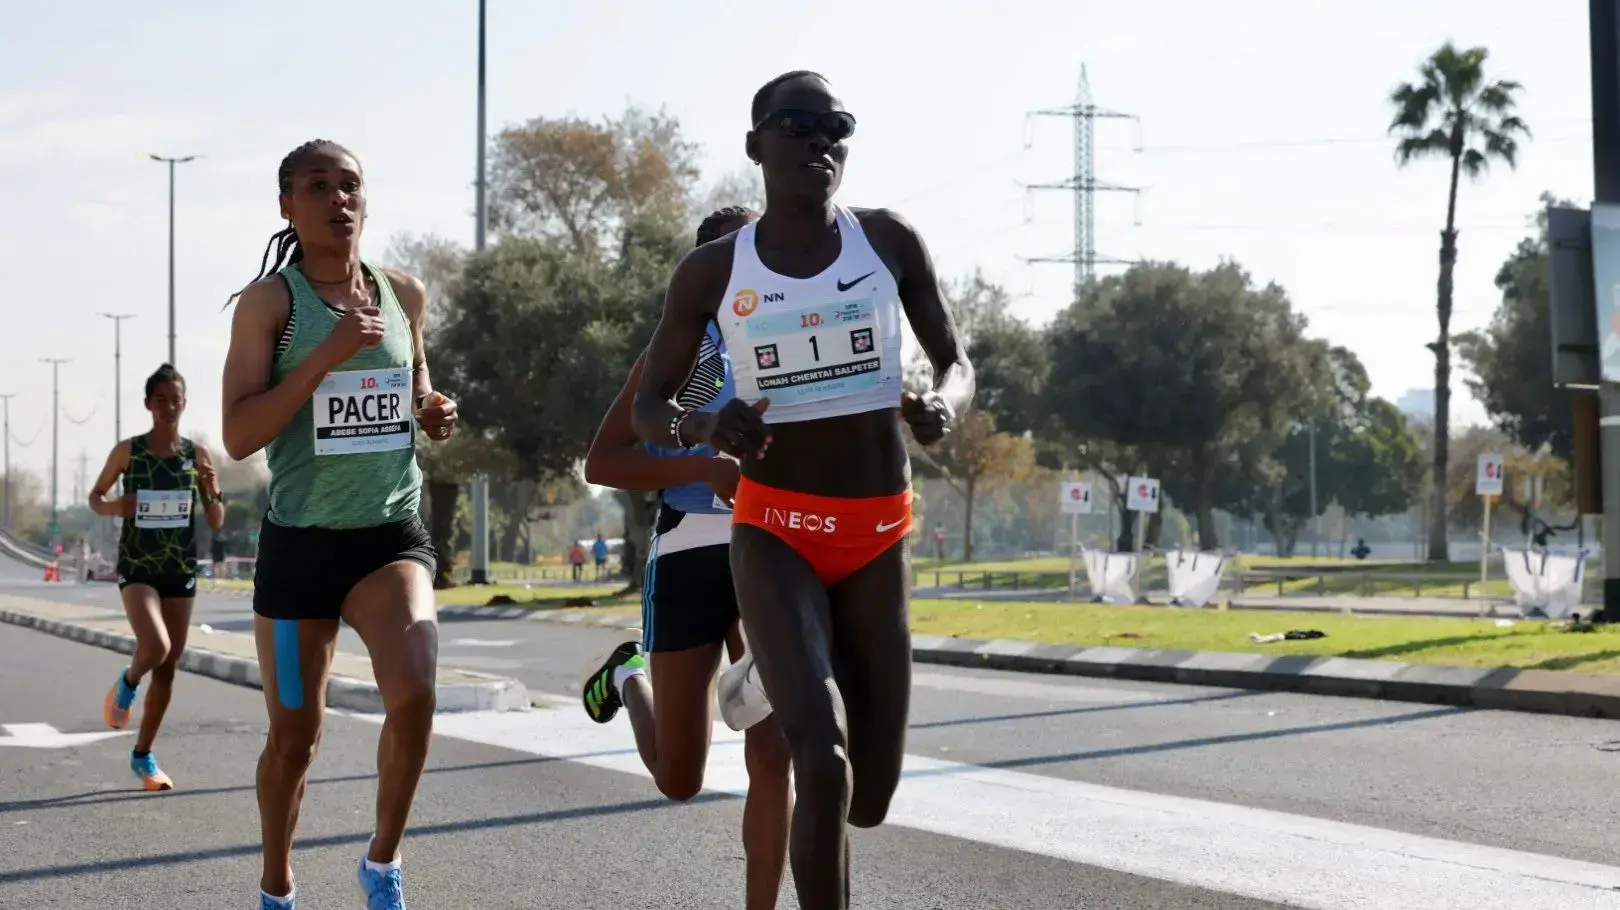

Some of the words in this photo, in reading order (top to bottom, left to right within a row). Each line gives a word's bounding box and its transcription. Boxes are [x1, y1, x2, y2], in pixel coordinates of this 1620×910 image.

[763, 292, 785, 303] NN
[809, 335, 820, 362] 1
[758, 375, 789, 388] LONAH
[791, 369, 833, 384] CHEMTAI
[834, 360, 880, 377] SALPETER
[328, 393, 401, 424] PACER
[330, 428, 357, 437] ABEBE
[358, 426, 379, 436] SOFIA
[764, 507, 837, 533] INEOS
